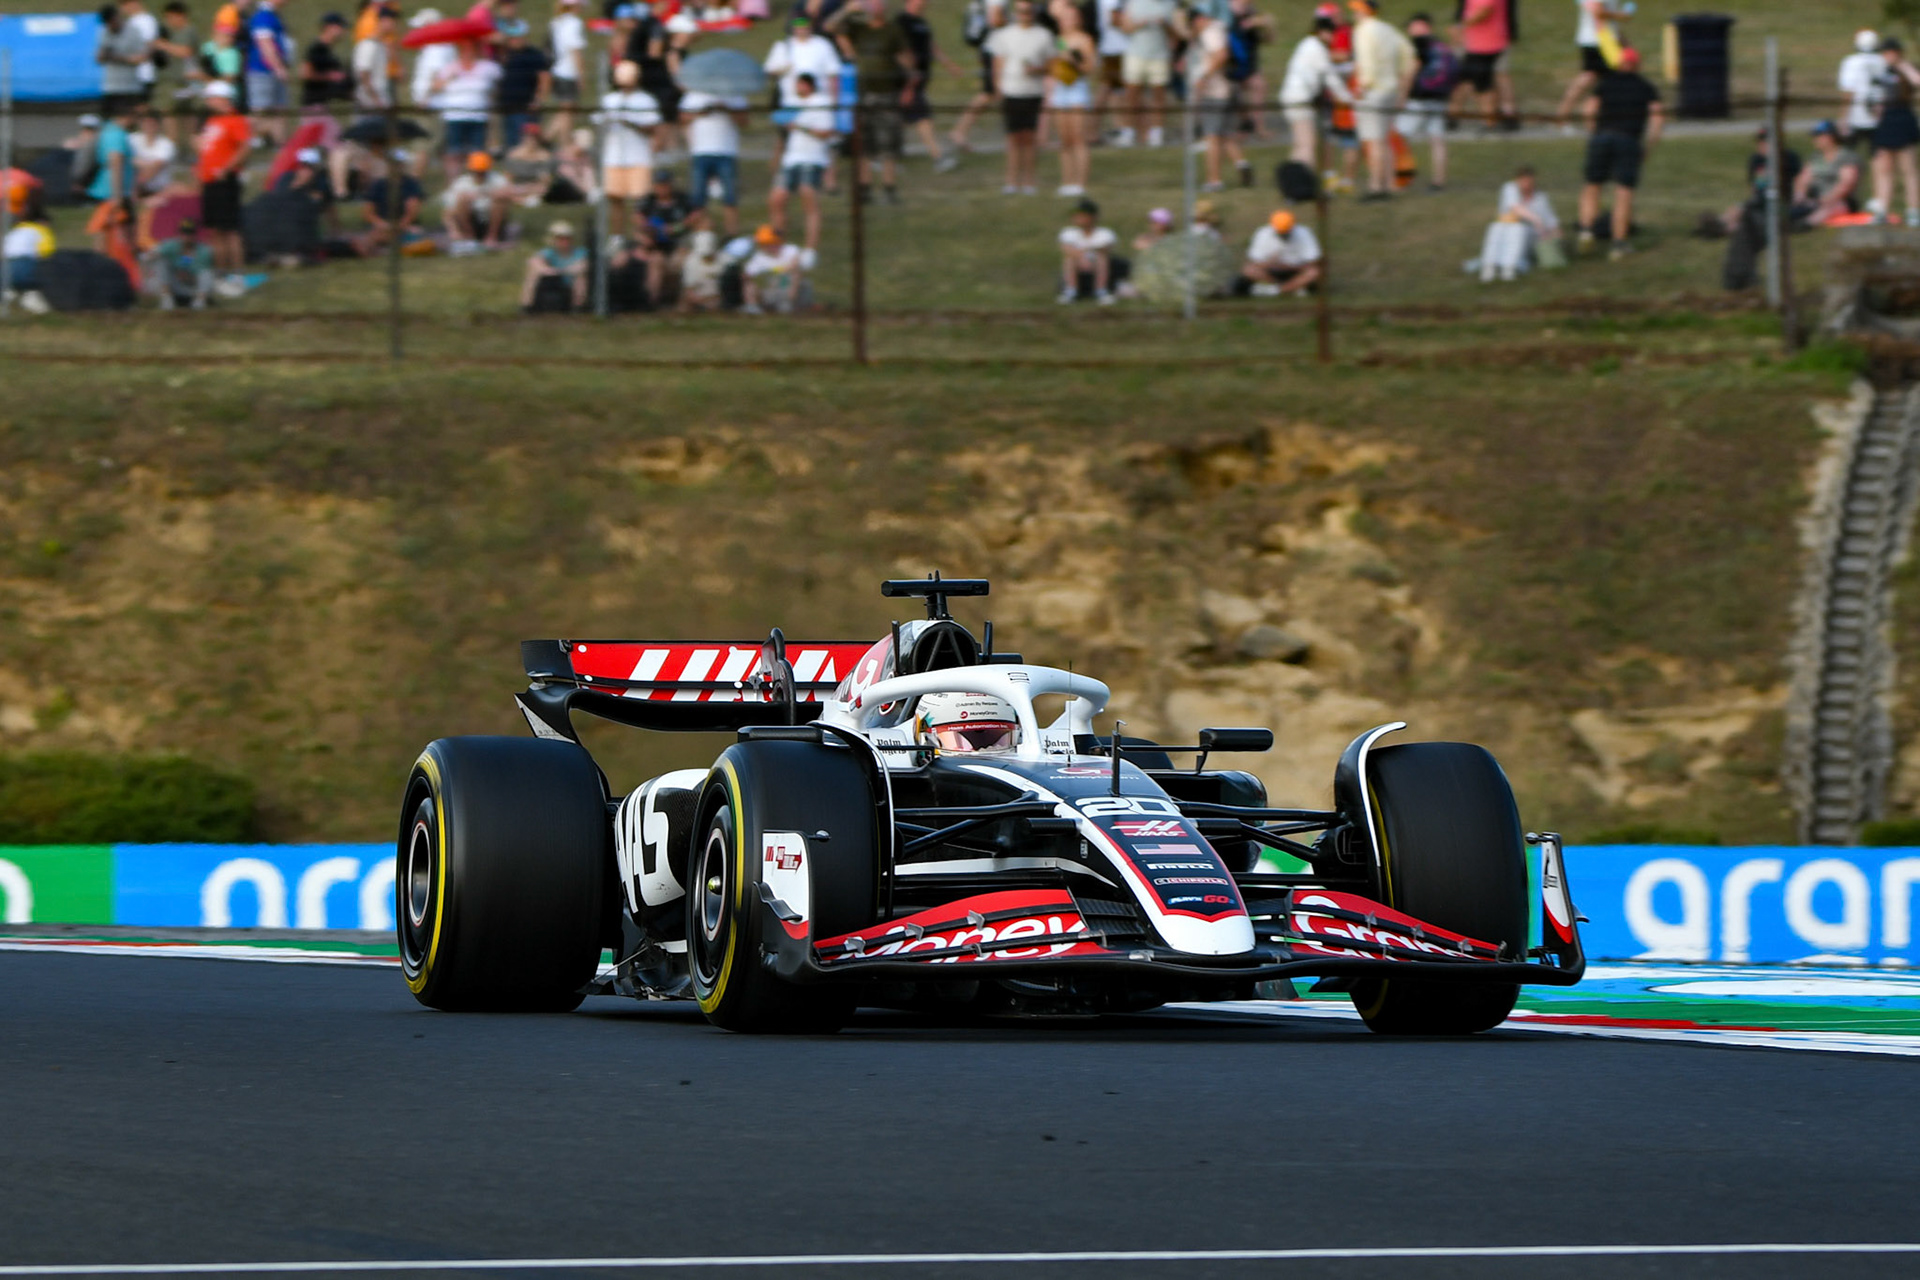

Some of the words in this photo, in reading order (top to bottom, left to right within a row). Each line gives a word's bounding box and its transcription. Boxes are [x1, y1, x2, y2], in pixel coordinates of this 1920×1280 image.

[1044, 740, 1070, 748] Palm
[1075, 796, 1182, 818] 20
[1146, 862, 1215, 870] PIRELLI
[1203, 894, 1230, 904] GO
